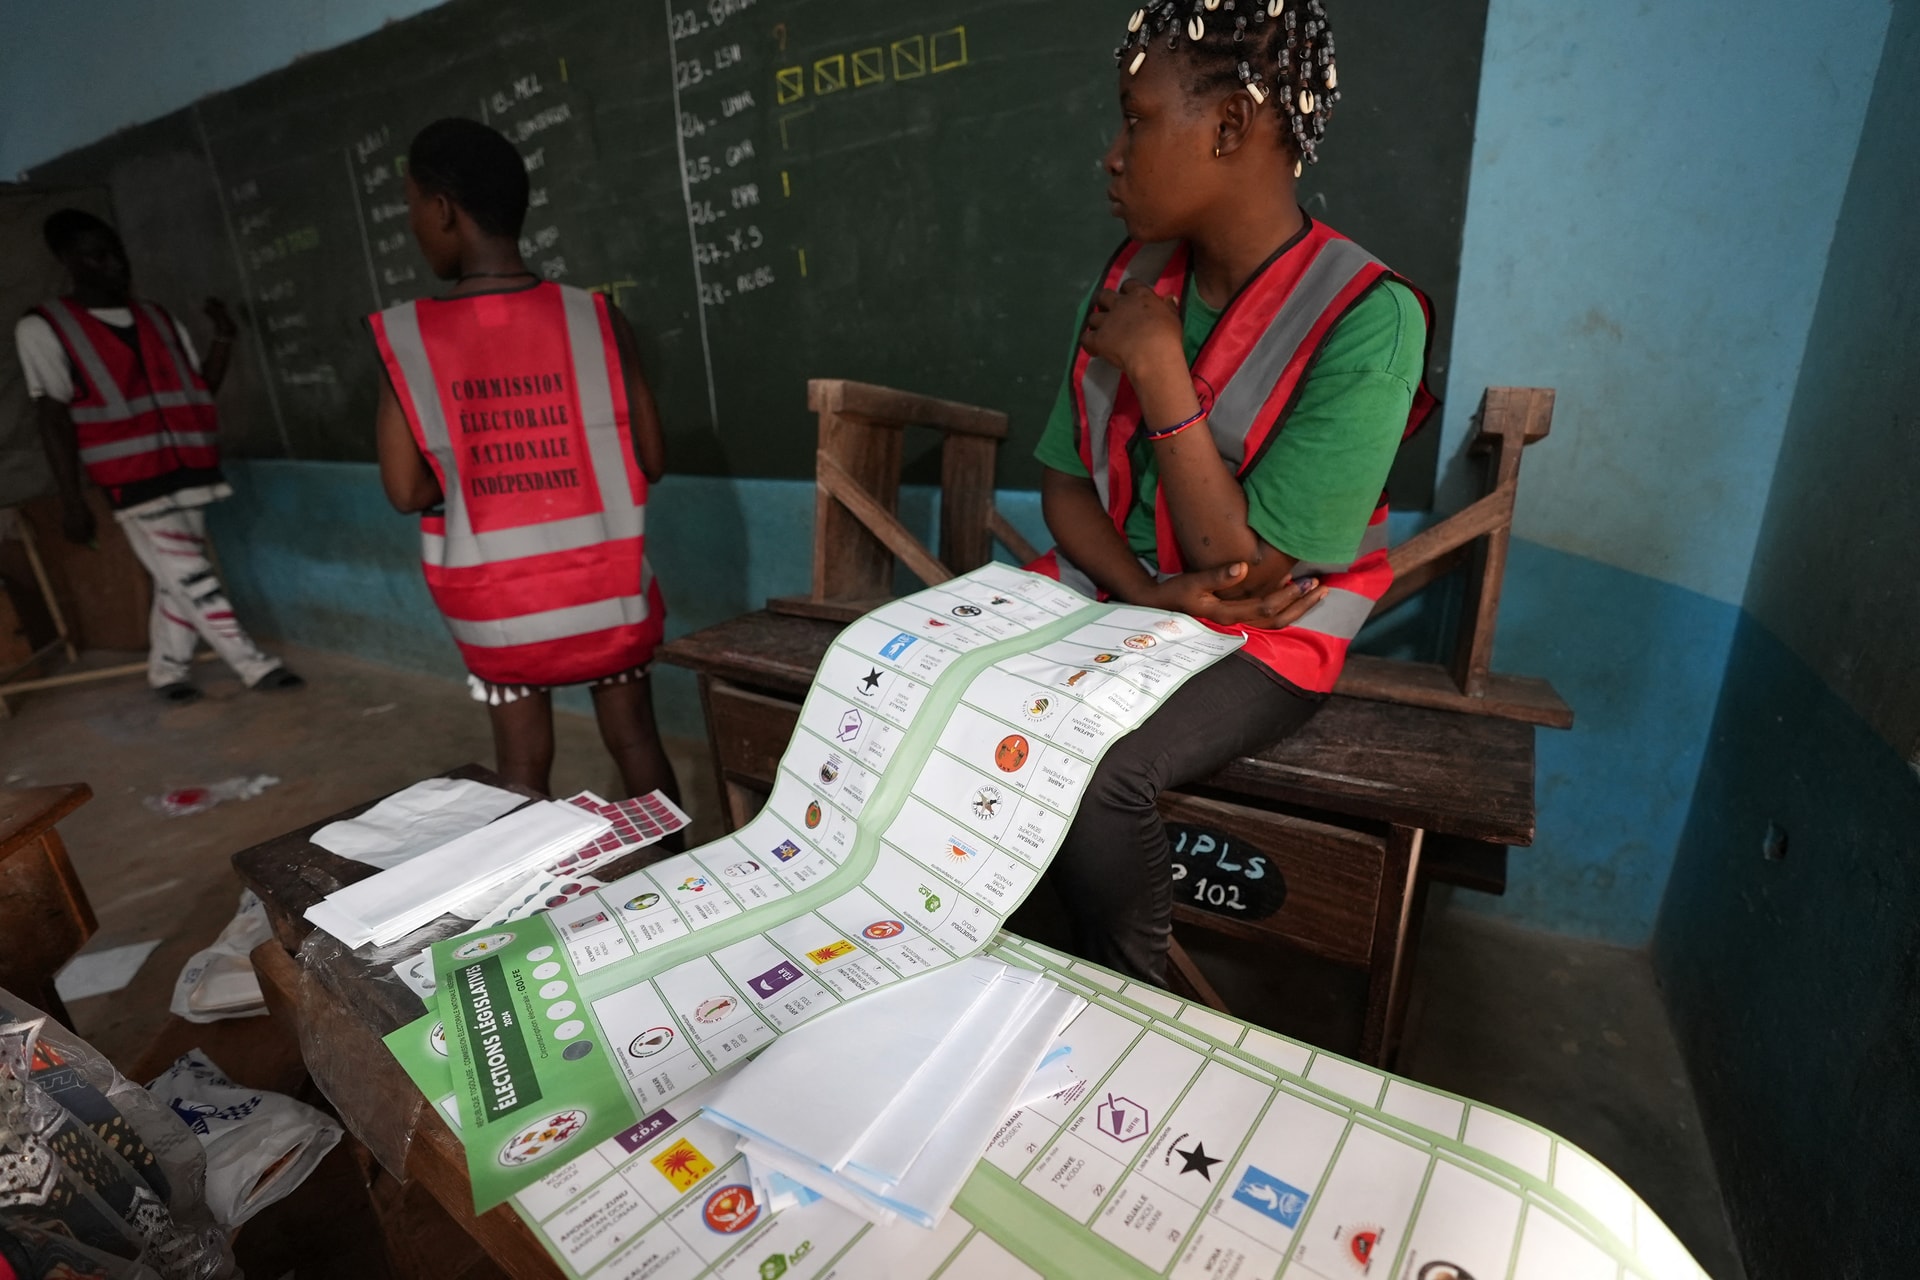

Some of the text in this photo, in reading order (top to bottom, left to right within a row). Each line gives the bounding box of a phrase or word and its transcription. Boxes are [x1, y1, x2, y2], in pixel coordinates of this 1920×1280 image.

[451, 372, 563, 401] COMMISSION
[459, 404, 568, 434] ÉLECTORALE
[471, 437, 570, 466] NATIONALE
[471, 468, 580, 498] INDÉPENDANTE
[1047, 776, 1065, 788] FABRE
[1016, 833, 1039, 849] MENSAH
[983, 882, 1004, 897] SOWOU
[992, 871, 1013, 886] NYASSA
[917, 885, 931, 898] ACP
[1194, 878, 1247, 910] 102
[960, 919, 978, 933] KODJO
[512, 968, 526, 992] GOLFE
[501, 1010, 512, 1027] 2024
[466, 964, 517, 1111] ÉLECTIONS LÉGISLATIVES
[528, 1021, 549, 1060] Circonscription
[630, 1118, 663, 1143] F.D.R
[997, 1119, 1022, 1149] DOSSEVI
[1070, 1116, 1086, 1133] BATIR
[1026, 1142, 1037, 1153] 21
[1051, 1155, 1076, 1183] TOVIAVE
[1064, 1158, 1085, 1181] KODJO
[1091, 1183, 1105, 1197] 22
[1122, 1194, 1148, 1226] ADJALLE
[1167, 1229, 1180, 1242] 23
[785, 1239, 813, 1264] ACP
